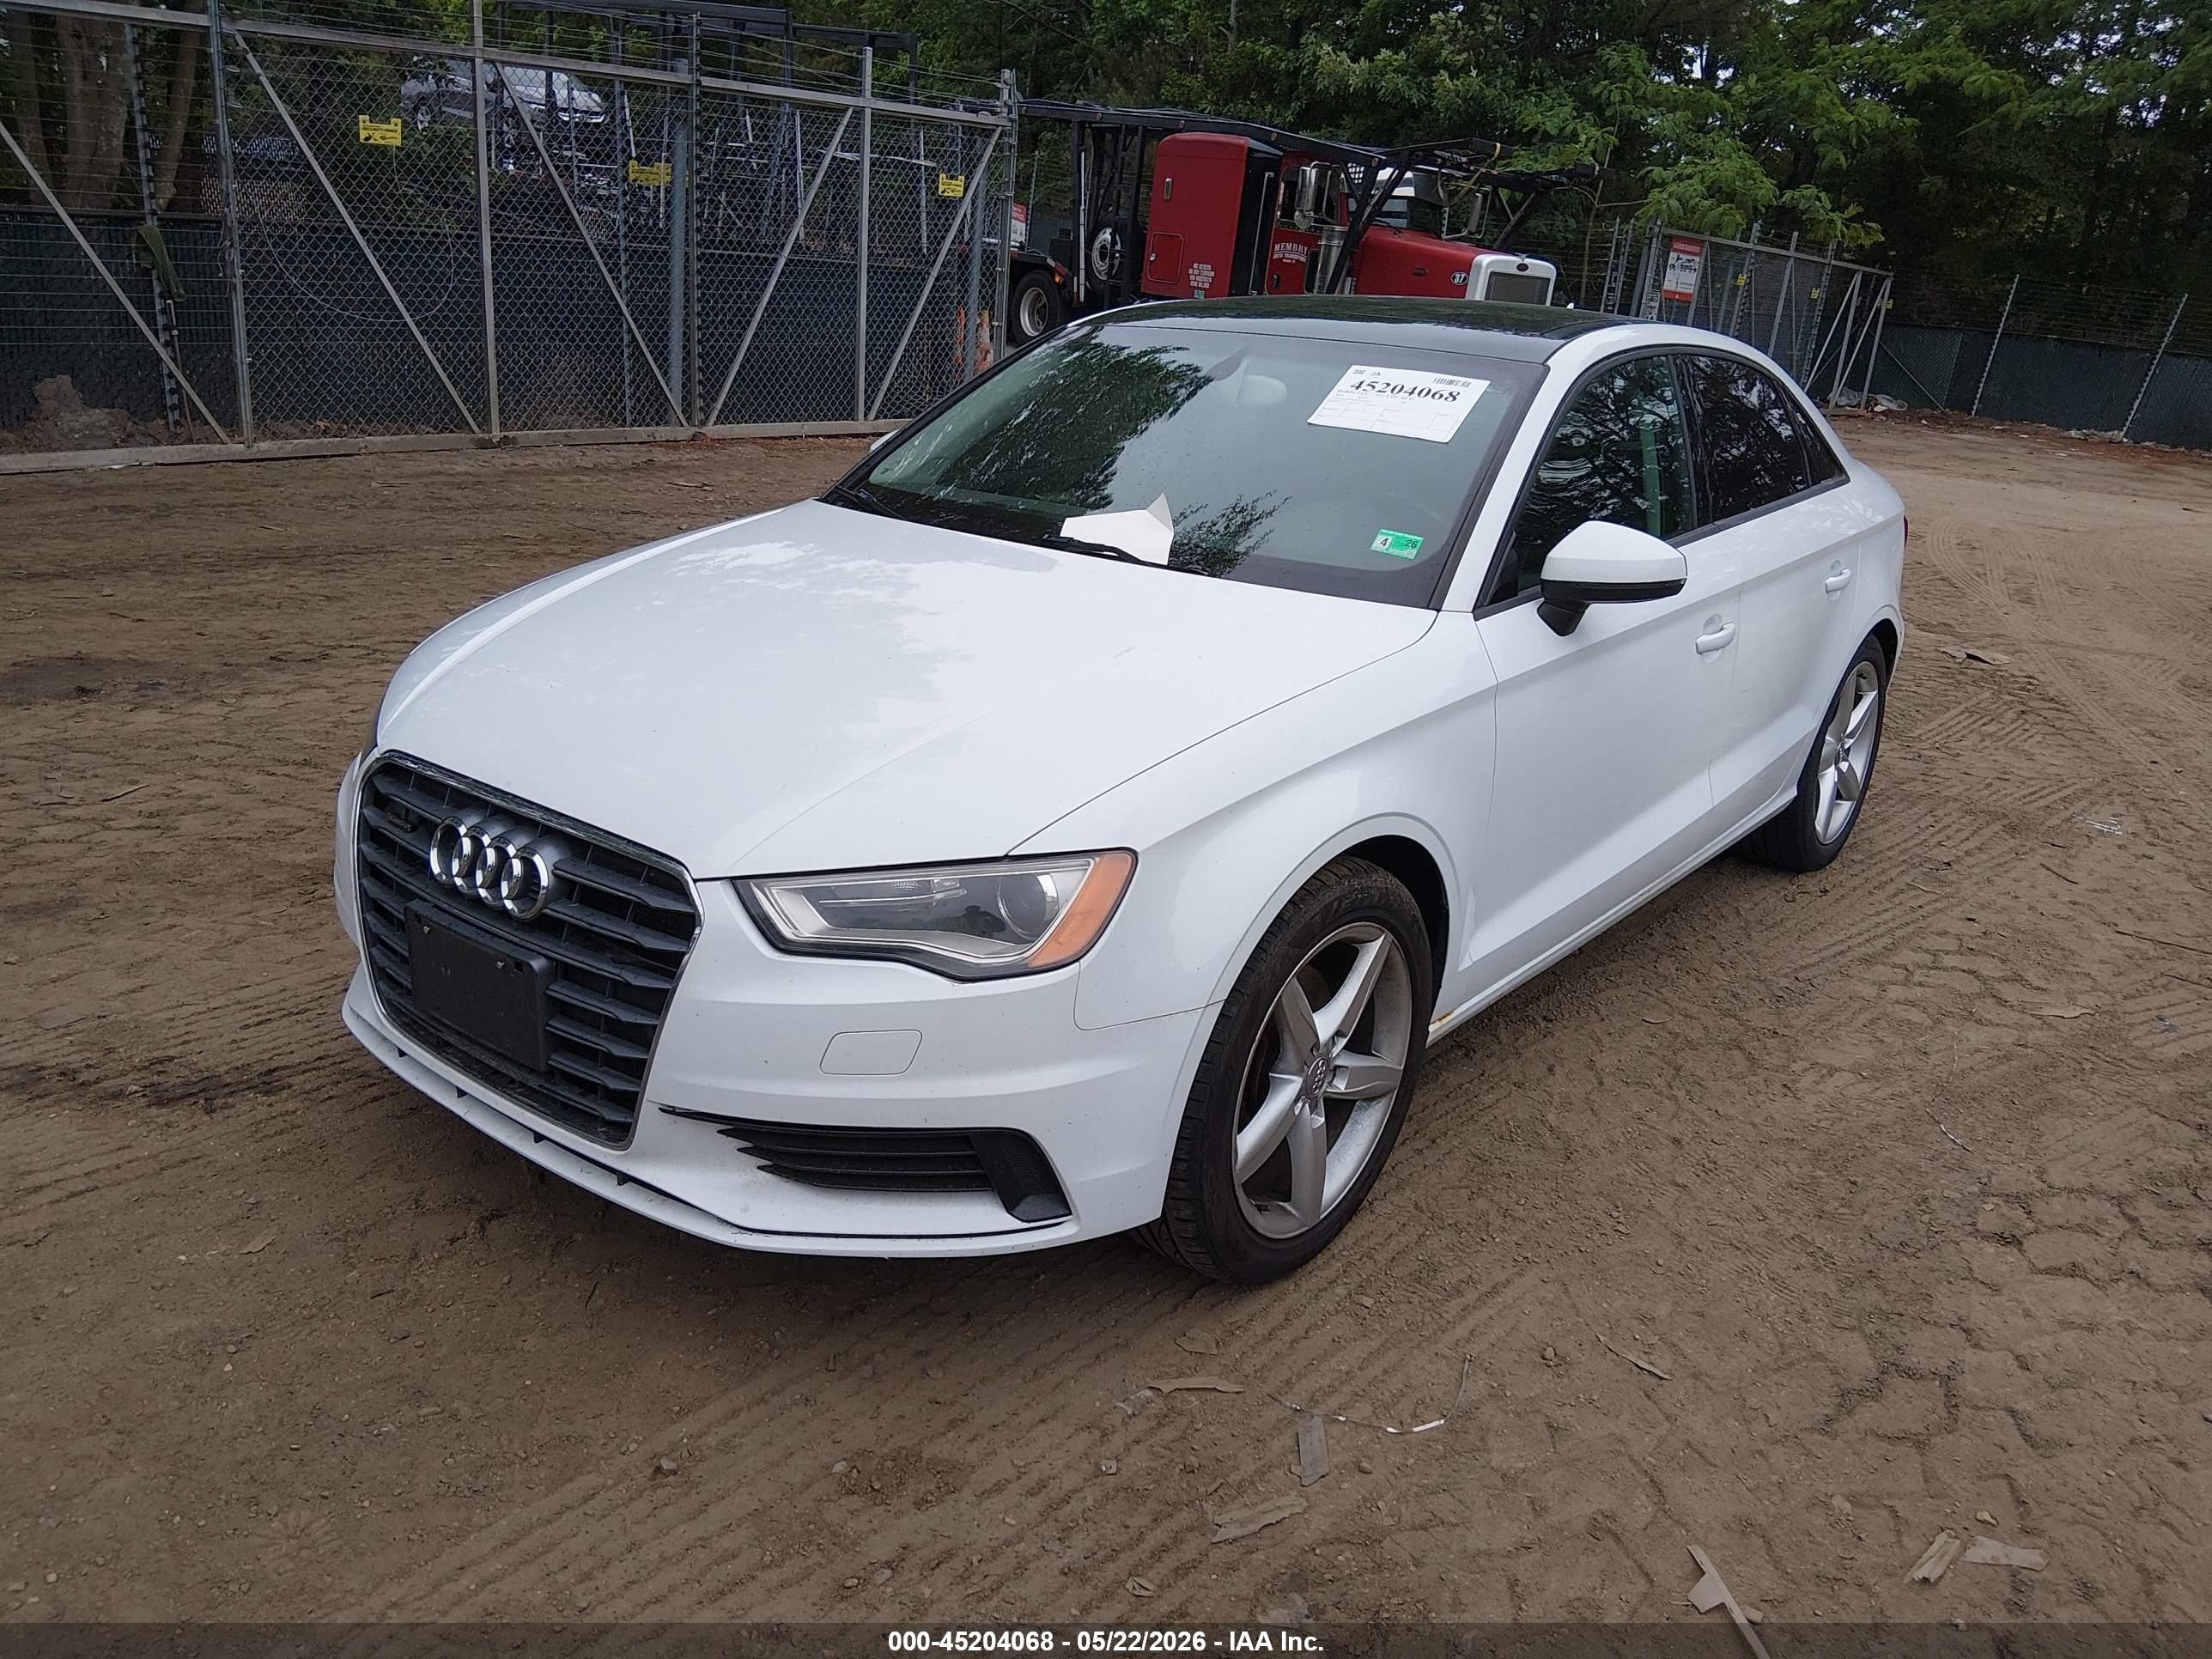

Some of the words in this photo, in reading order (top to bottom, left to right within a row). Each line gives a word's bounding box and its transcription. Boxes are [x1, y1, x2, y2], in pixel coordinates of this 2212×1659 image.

[1274, 242, 1309, 254] MEMORY
[1454, 273, 1465, 284] 37
[1350, 380, 1462, 403] 45204068
[1380, 538, 1389, 547] 4
[1404, 538, 1419, 549] 26
